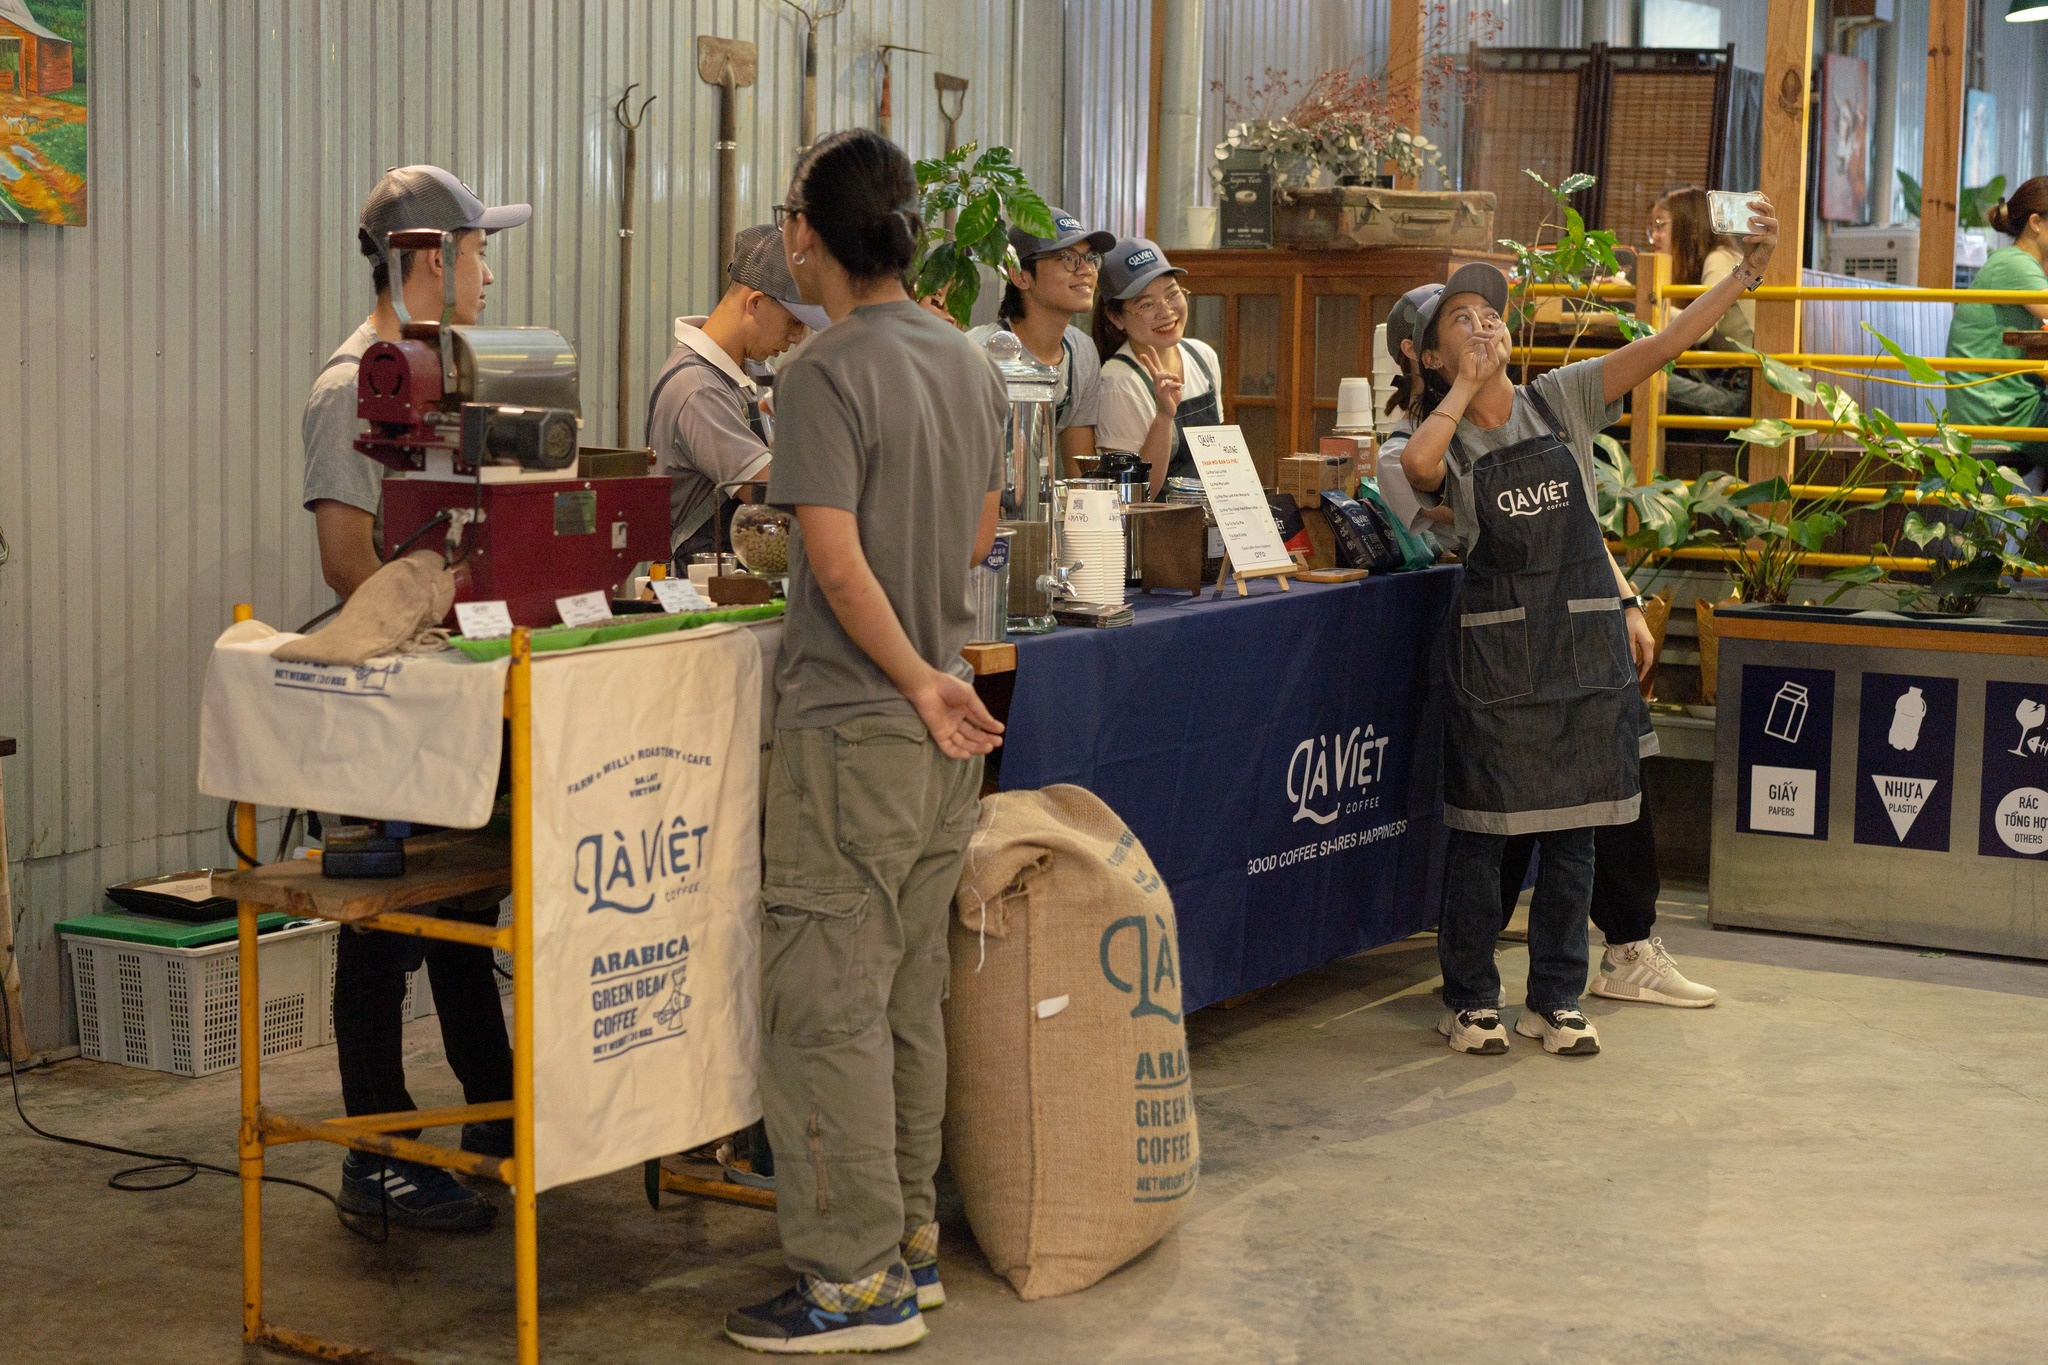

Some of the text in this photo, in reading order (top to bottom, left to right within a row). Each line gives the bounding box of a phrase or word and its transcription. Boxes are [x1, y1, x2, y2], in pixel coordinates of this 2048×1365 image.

[1497, 480, 1568, 517] LÀ VIỆT
[1547, 501, 1570, 510] COFFEE
[276, 668, 288, 678] NET
[568, 746, 712, 795] FARM MILL ROASTERY CAFE
[1286, 724, 1389, 824] LÀ VIỆT
[1769, 781, 1798, 802] GIẤY
[1884, 780, 1923, 801] NHỰA
[1346, 796, 1380, 814] COFFEE
[1768, 806, 1795, 817] PAPERS
[1888, 803, 1918, 815] PLASTIC
[2019, 794, 2038, 809] RÁC
[2004, 811, 2030, 827] TỔNG
[1248, 820, 1408, 875] GOOD COFFEE SHARES HAPPINESS
[2015, 833, 2042, 844] OTHERS
[574, 816, 709, 914] LÀ VIỆT
[664, 881, 700, 902] COFFEE
[590, 935, 690, 977] ARABICA
[592, 981, 634, 1012] GREEN
[592, 1007, 638, 1039] COFFEE
[1135, 1049, 1186, 1080] ARA
[1136, 1095, 1186, 1127] GREEN
[1136, 1132, 1190, 1165] COFFEE
[1137, 1176, 1158, 1191] NET
